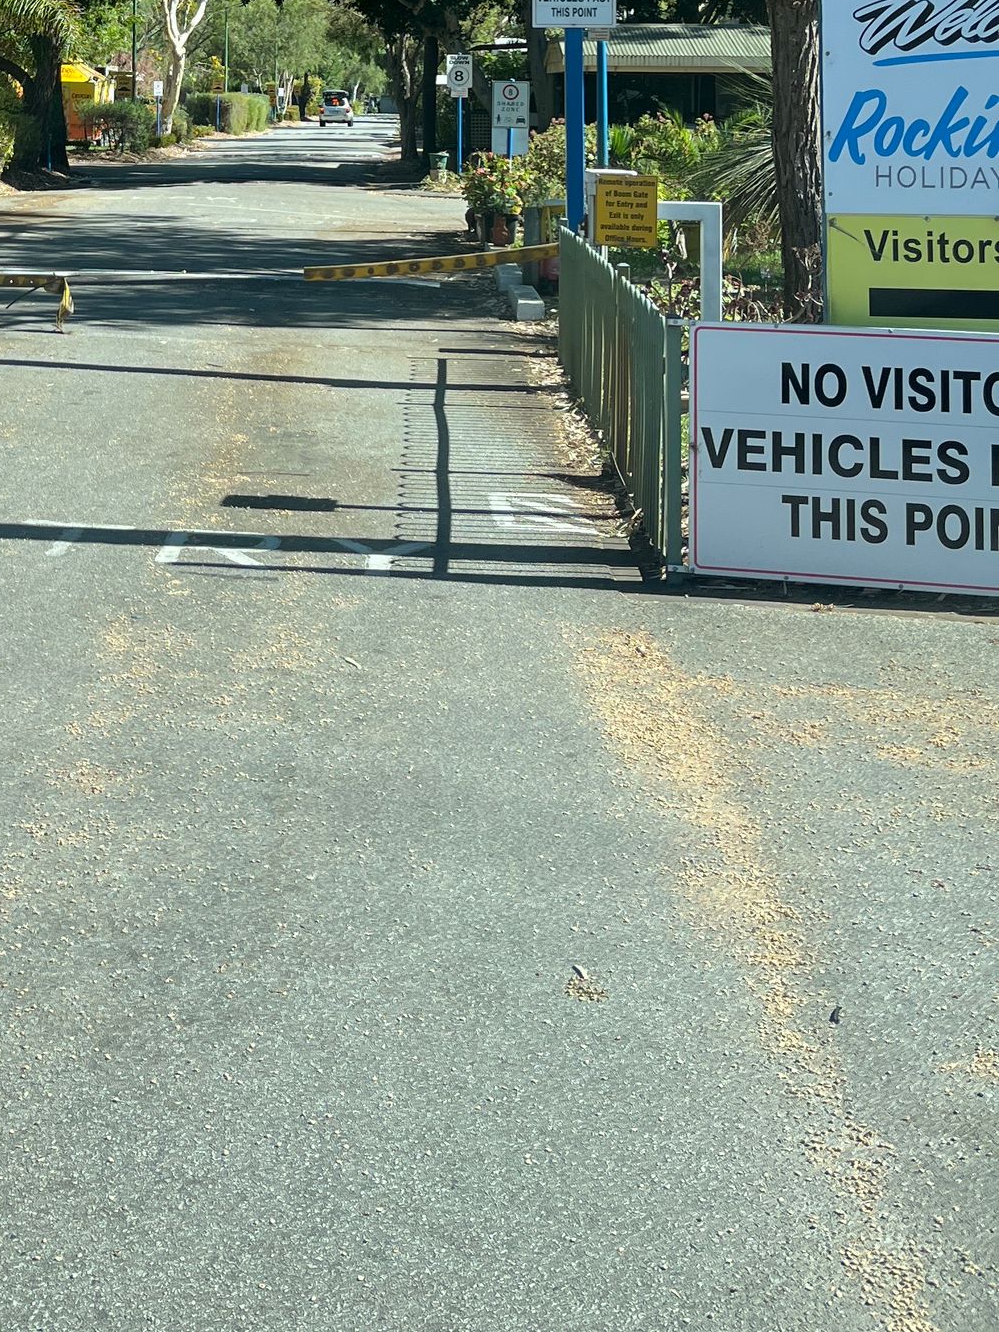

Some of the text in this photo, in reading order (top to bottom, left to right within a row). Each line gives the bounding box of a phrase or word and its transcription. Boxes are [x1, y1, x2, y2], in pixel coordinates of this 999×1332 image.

[551, 7, 598, 18] THIS POINT
[454, 70, 464, 82] 8
[624, 179, 655, 187] operation
[616, 201, 634, 209] Entry
[630, 213, 644, 221] only
[631, 224, 652, 233] during
[604, 234, 625, 242] Office
[864, 228, 999, 264] Visitor
[781, 362, 848, 408] NO
[701, 427, 971, 485] VEHICLES
[781, 494, 889, 544] THIS
